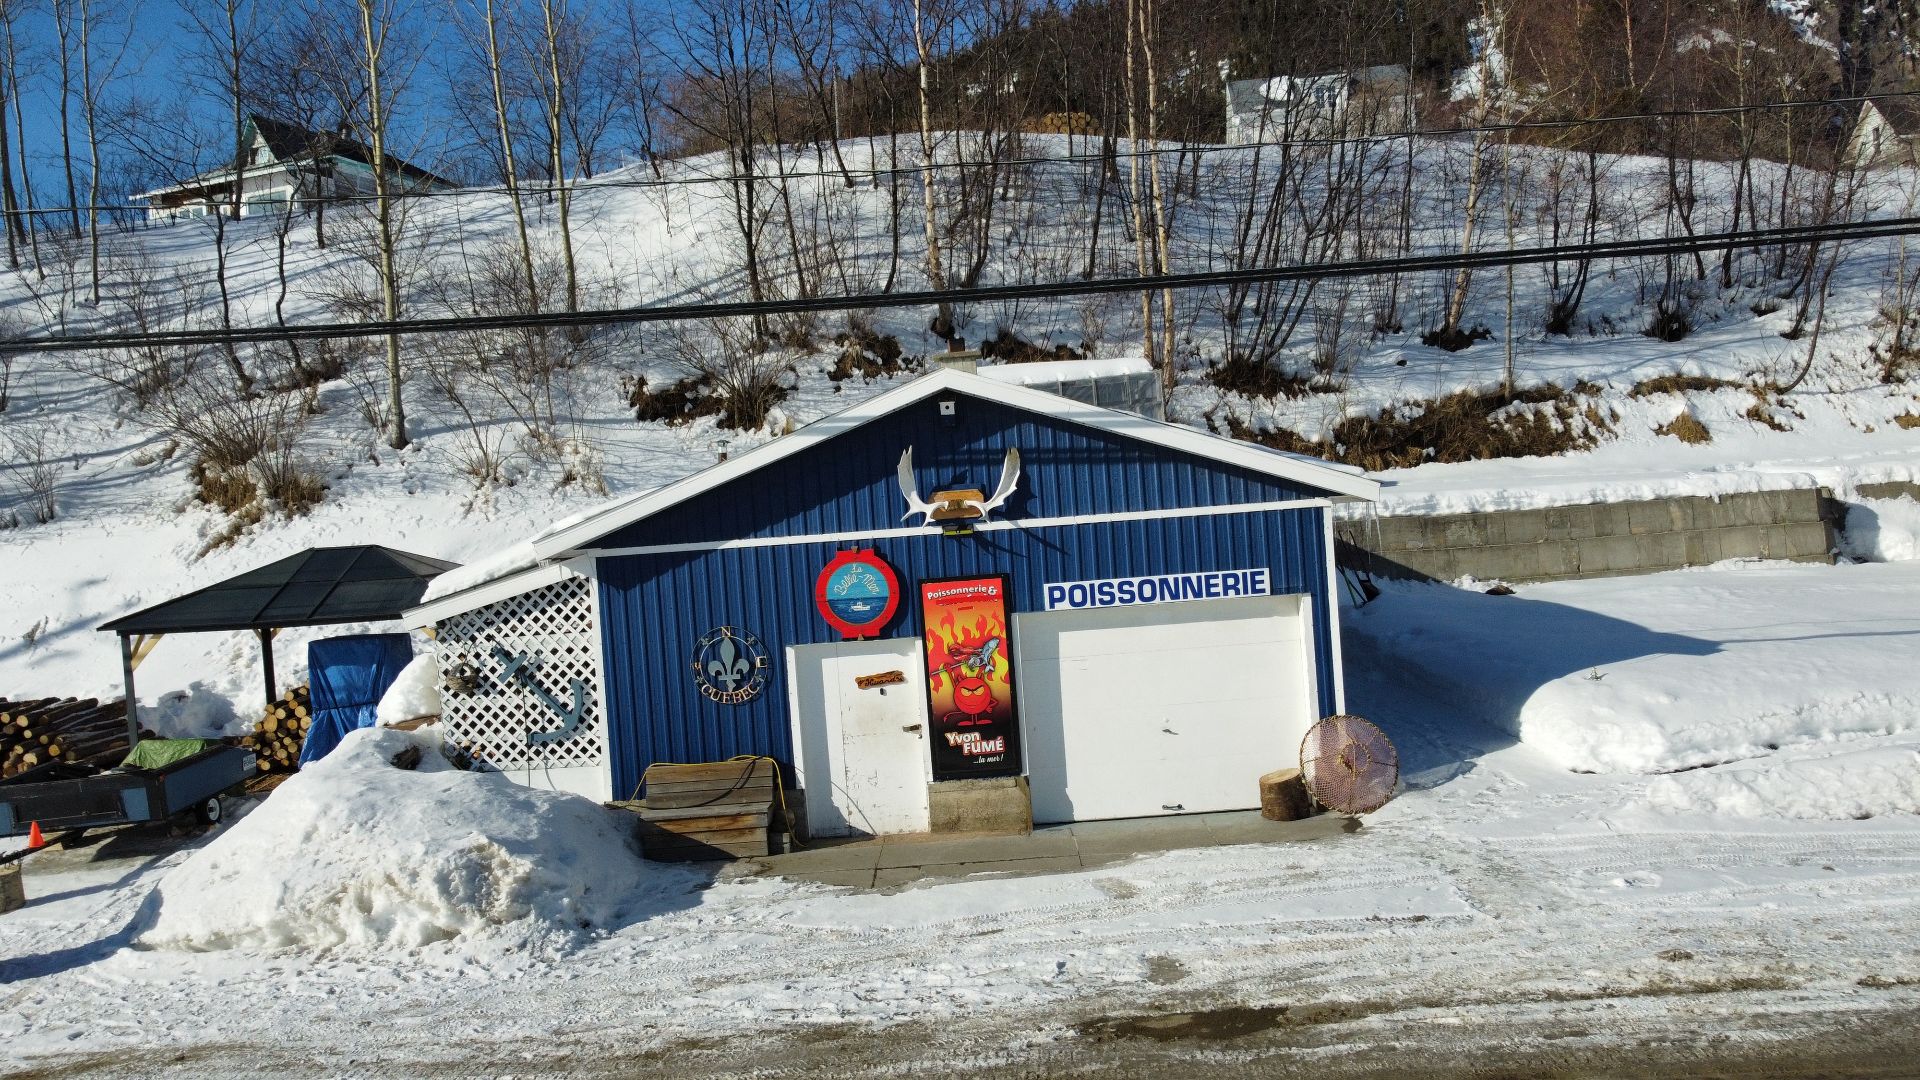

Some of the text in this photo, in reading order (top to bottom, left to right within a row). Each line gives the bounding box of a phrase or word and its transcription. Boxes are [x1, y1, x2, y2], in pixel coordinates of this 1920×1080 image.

[851, 563, 863, 573] La
[927, 585, 987, 600] Poissonnerie
[1047, 570, 1267, 610] POISSONNERIE
[945, 732, 980, 745] Yvon
[963, 737, 1004, 754] FUMÉ
